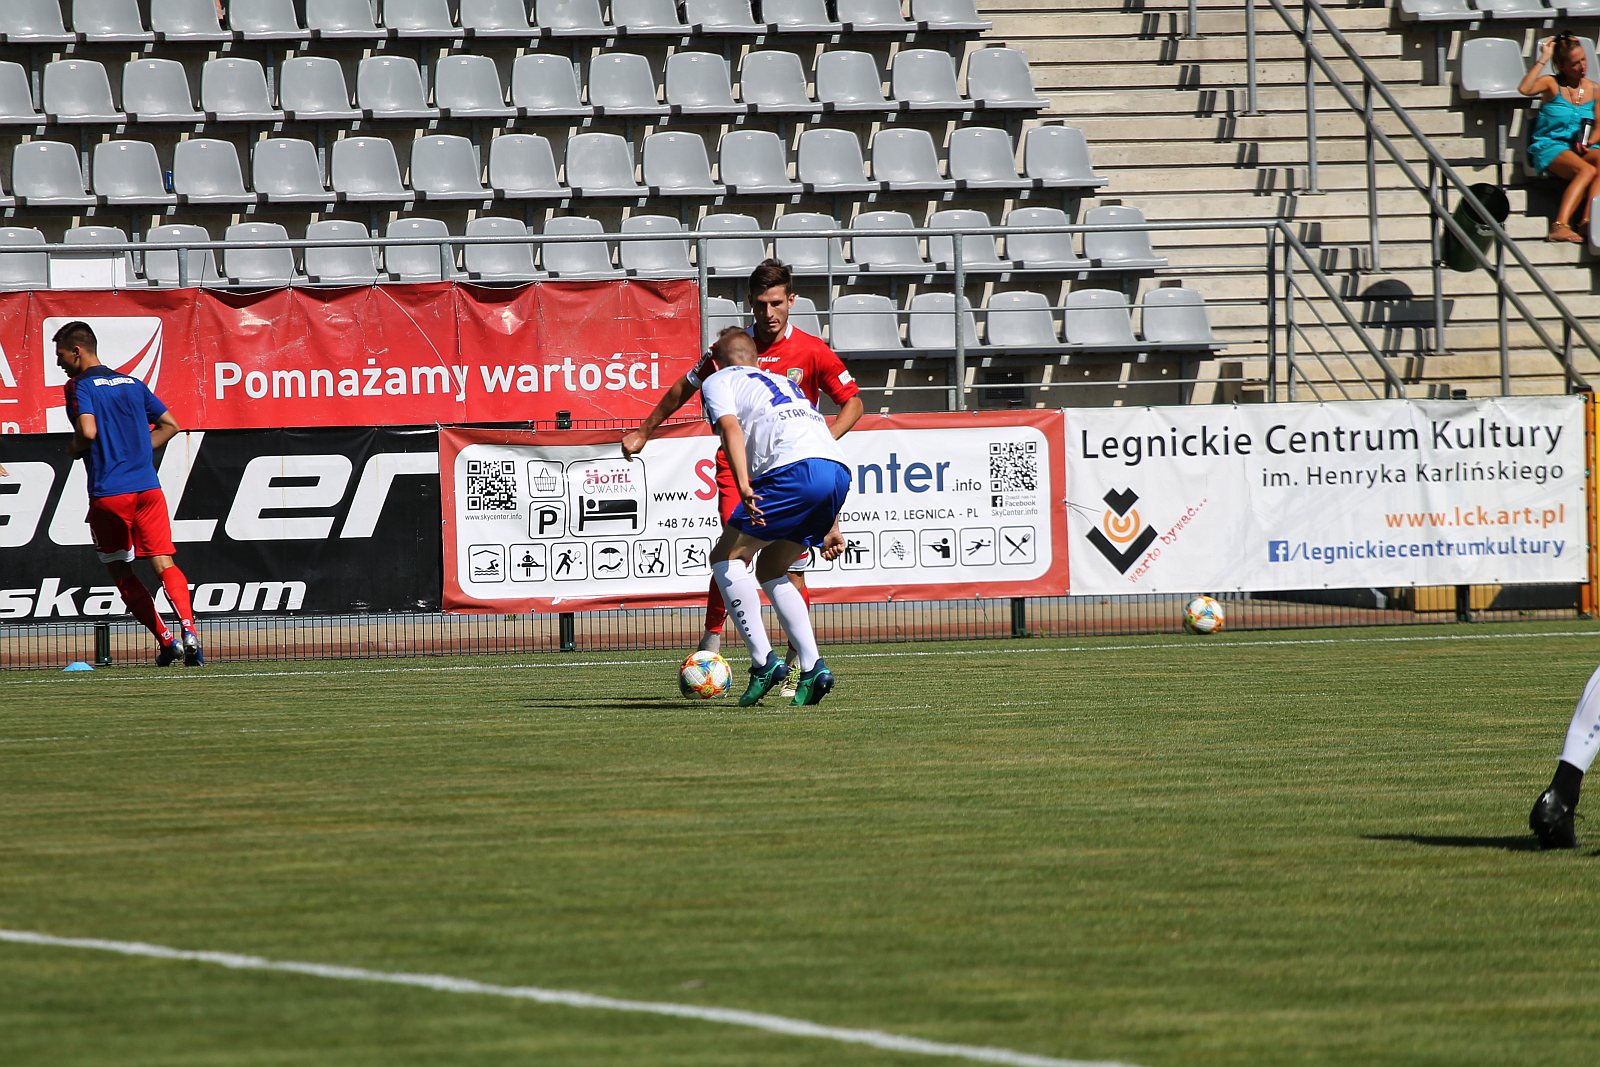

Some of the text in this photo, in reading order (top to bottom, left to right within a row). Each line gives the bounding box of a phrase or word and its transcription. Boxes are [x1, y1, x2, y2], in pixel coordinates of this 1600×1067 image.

[214, 353, 659, 402] Pomnażamy wartości
[1081, 417, 1563, 466] Legnickie Centrum Kultury
[585, 469, 632, 485] HOTEL
[1262, 460, 1563, 489] im. Henryka Karlińskiego
[582, 479, 637, 494] GWARNA
[465, 513, 522, 521] www.skycenter.info
[657, 517, 718, 528] +48 76 745
[904, 509, 955, 520] LEGNICA
[967, 508, 978, 518] PL
[1385, 503, 1565, 528] www.lck.art.pl
[1128, 547, 1161, 583] warto
